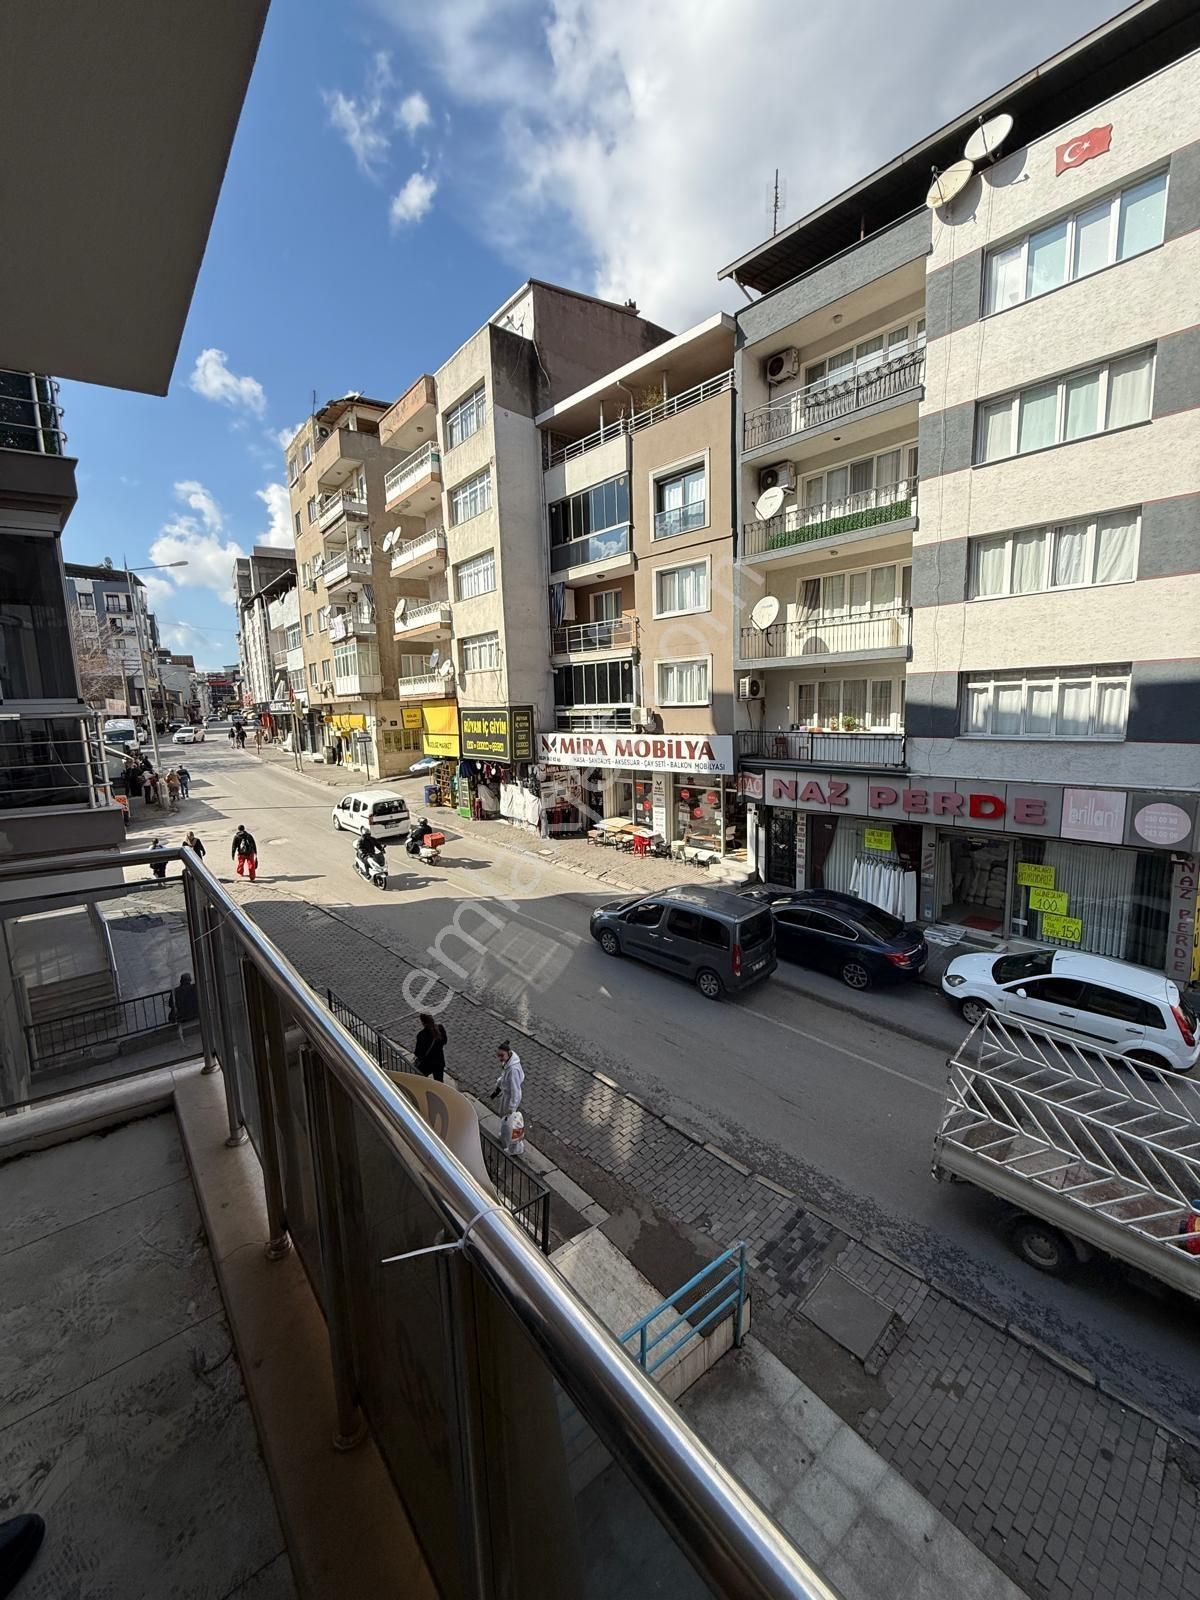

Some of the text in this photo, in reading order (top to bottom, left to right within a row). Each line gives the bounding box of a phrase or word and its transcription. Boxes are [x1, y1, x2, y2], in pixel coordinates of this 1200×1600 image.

[670, 761, 693, 769] BALKON
[773, 779, 1047, 825] NAZ PERDE
[1061, 924, 1081, 941] 150
[1173, 862, 1195, 972] NAZ PERDE
